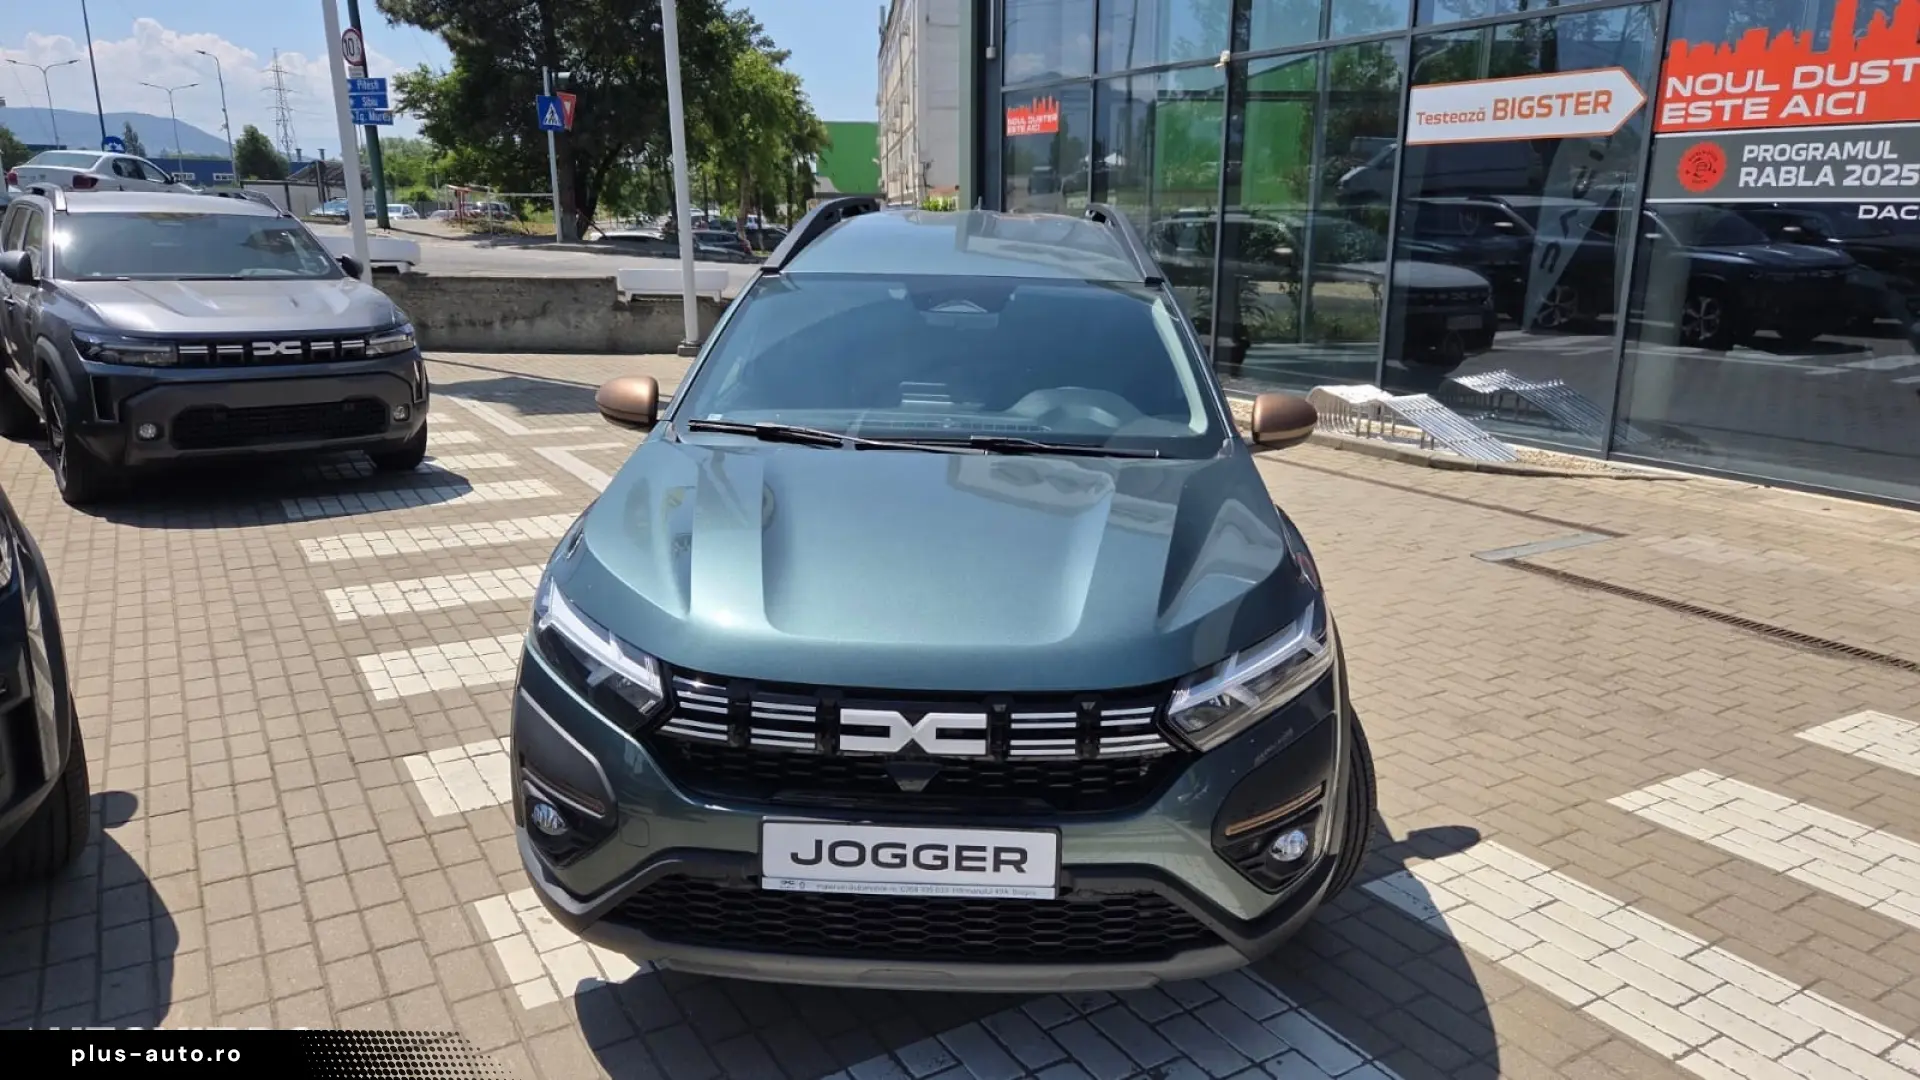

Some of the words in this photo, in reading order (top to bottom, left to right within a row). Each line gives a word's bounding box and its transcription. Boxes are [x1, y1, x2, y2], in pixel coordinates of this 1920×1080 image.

[1665, 69, 1780, 98] NOUL
[1416, 107, 1486, 126] Testează
[1491, 89, 1613, 121] BIGSTER
[1661, 97, 1771, 125] ESTE
[1779, 91, 1867, 119] AICI
[1742, 140, 1898, 163] PROGRAMUL
[1738, 164, 1836, 188] RABLA
[1842, 163, 1920, 187] 2025
[1857, 204, 1920, 220] DAC
[790, 839, 1028, 874] JOGGER
